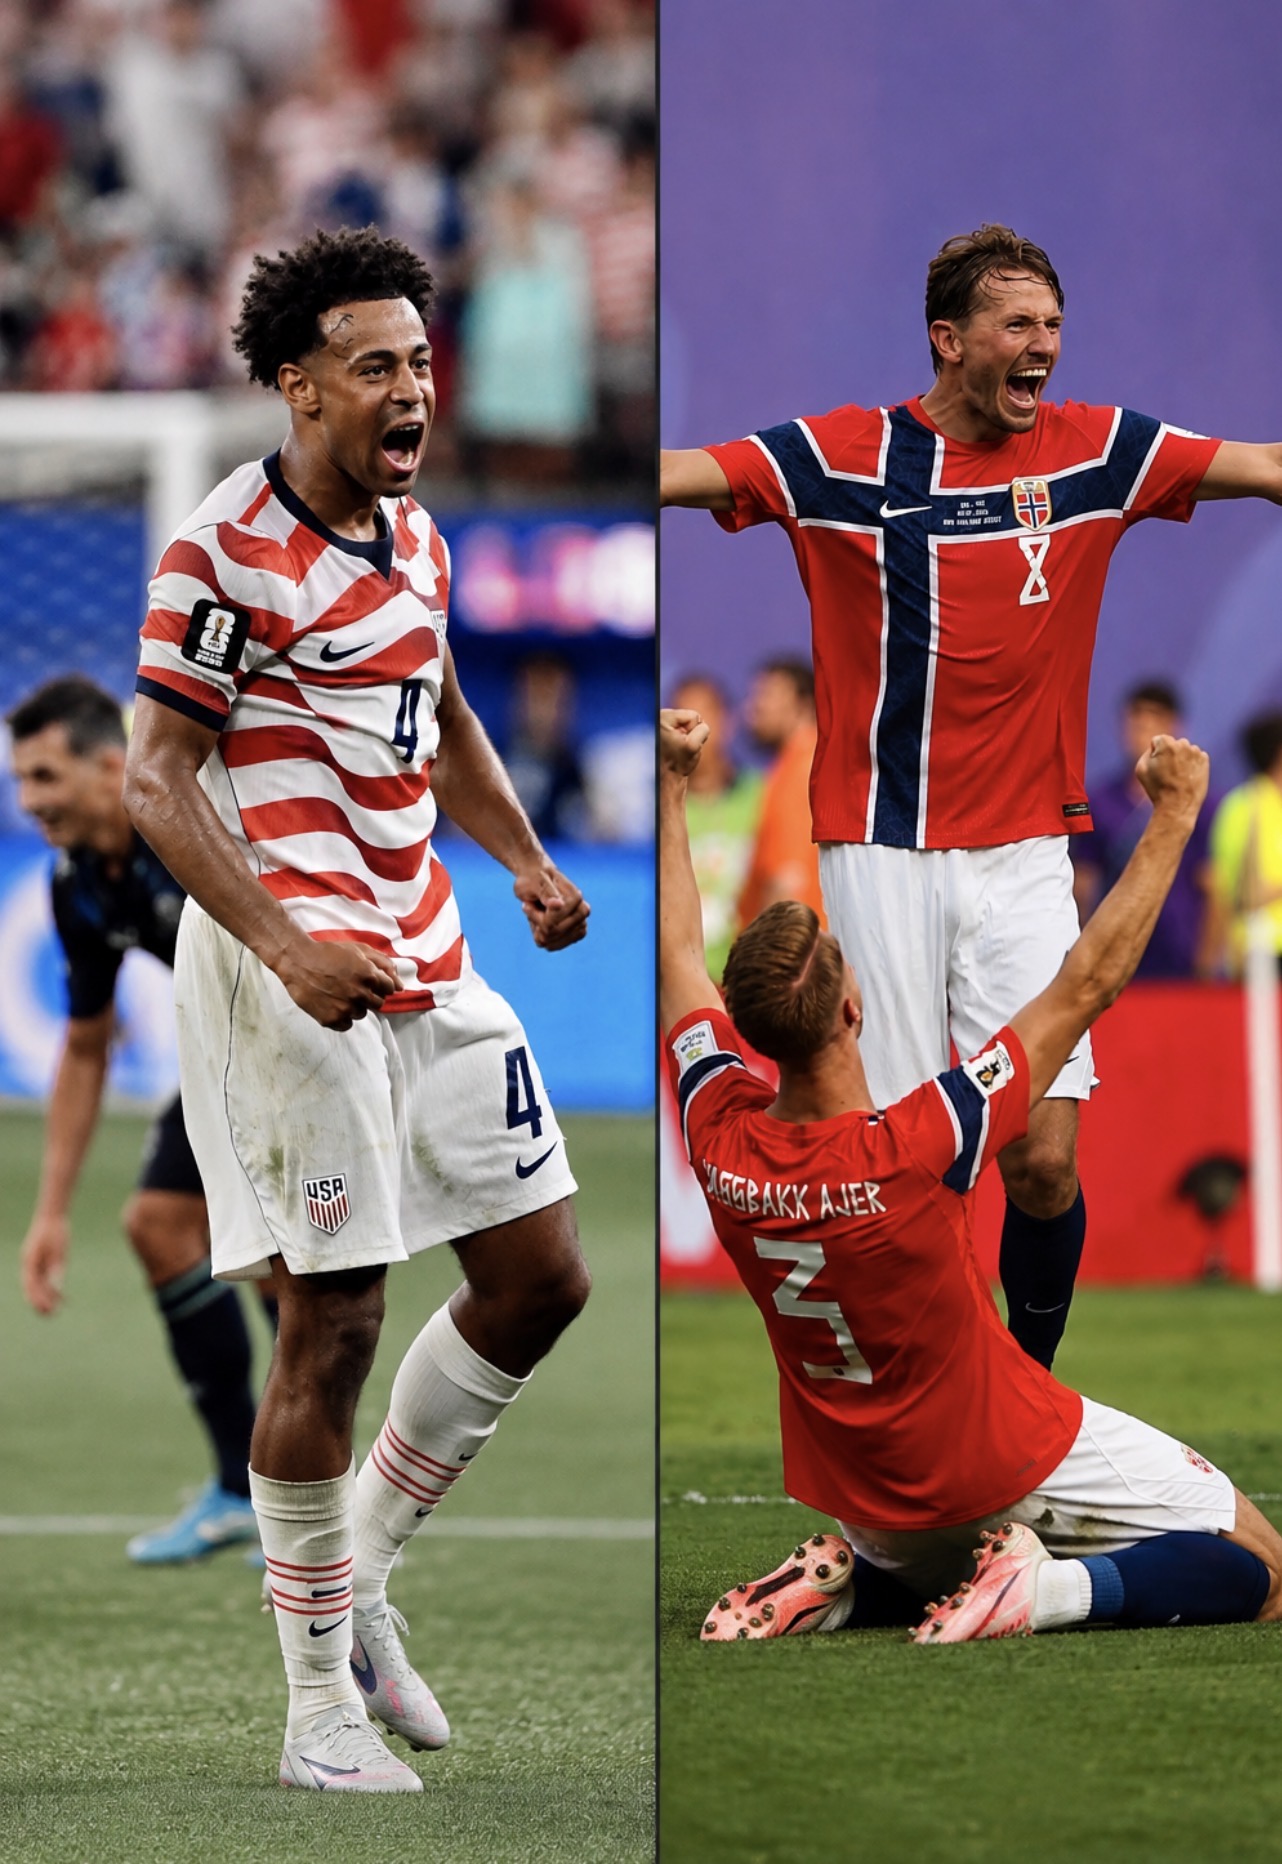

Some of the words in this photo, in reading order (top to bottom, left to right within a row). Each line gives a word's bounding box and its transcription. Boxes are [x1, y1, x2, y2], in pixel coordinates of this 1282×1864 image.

[1018, 534, 1050, 606] 8
[391, 679, 423, 764] 4
[505, 1046, 542, 1139] 4
[306, 1178, 344, 1202] USA
[820, 1181, 887, 1220] AJER
[753, 1236, 873, 1384] 3
